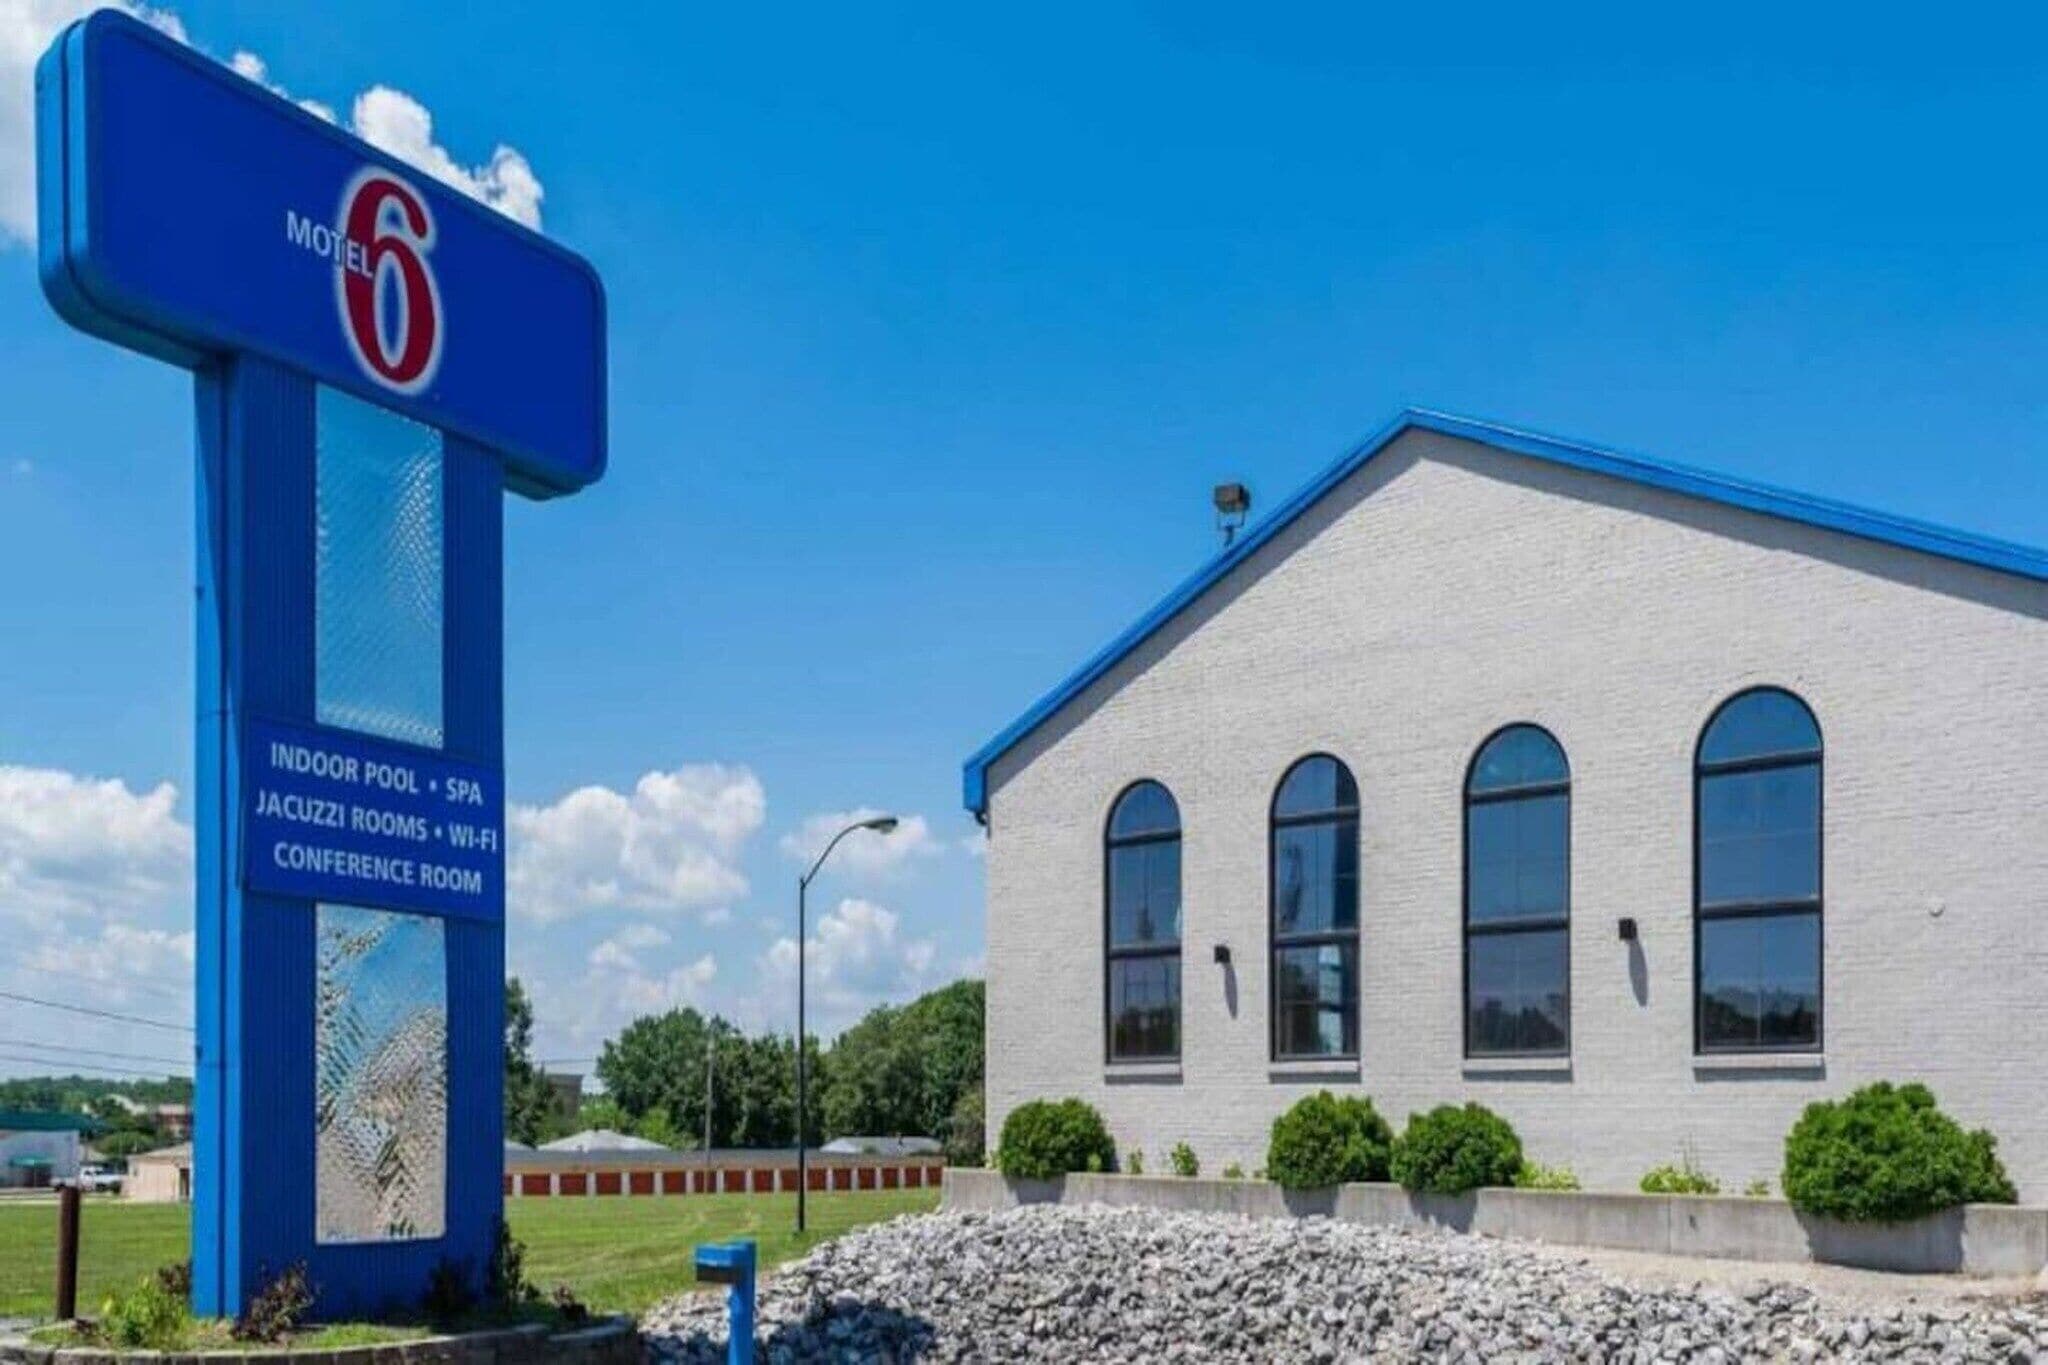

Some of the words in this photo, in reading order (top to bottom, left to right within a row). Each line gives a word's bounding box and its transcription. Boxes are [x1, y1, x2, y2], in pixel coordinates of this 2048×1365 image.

[287, 210, 373, 279] MOTEL
[337, 169, 441, 392] 6
[271, 742, 359, 782] INDOOR
[364, 760, 419, 794] POOL
[446, 777, 483, 806] SPA
[256, 790, 345, 828] JACUZZI
[352, 807, 427, 842] ROOMS
[449, 823, 498, 853] WI-FI
[274, 841, 415, 885] CONFERENCE
[420, 862, 482, 894] ROOM
